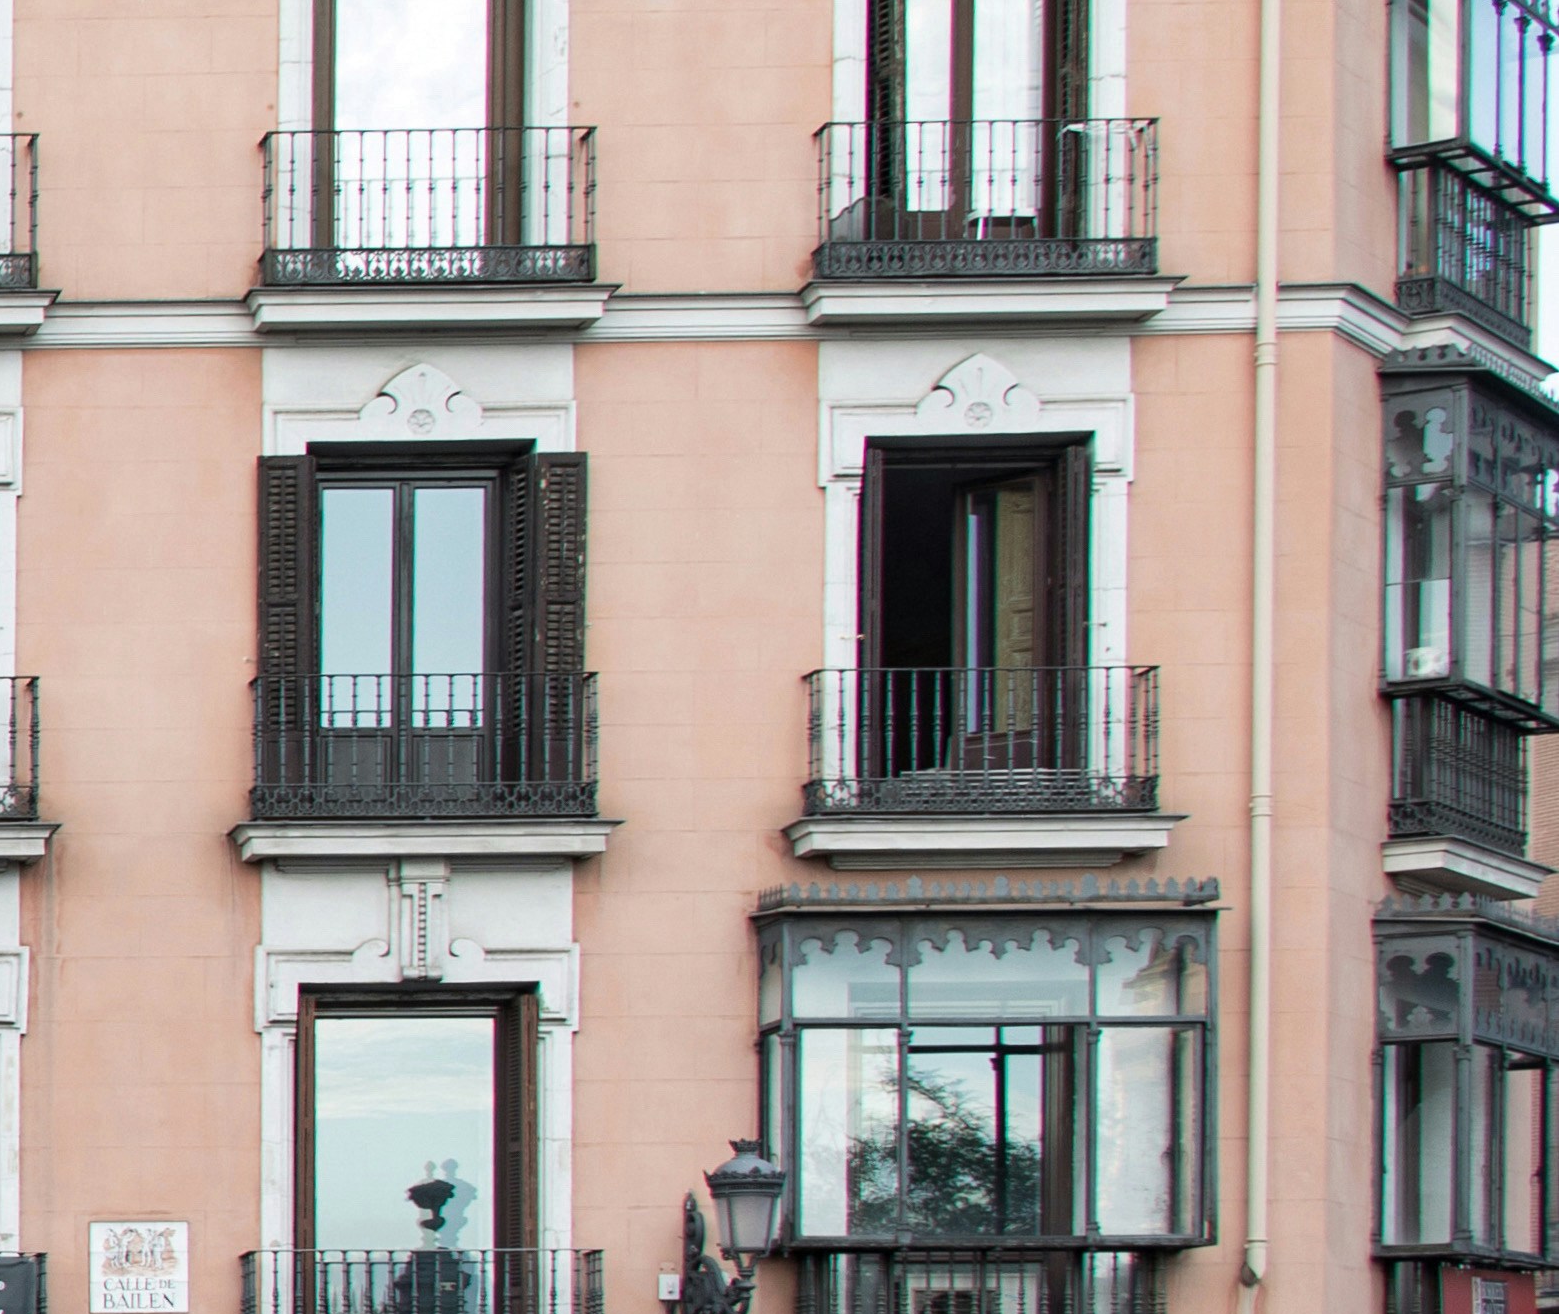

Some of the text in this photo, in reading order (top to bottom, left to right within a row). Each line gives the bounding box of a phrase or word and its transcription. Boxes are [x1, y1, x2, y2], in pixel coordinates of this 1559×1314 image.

[103, 1278, 176, 1291] CALLE DE
[103, 1293, 176, 1309] BAILEN
